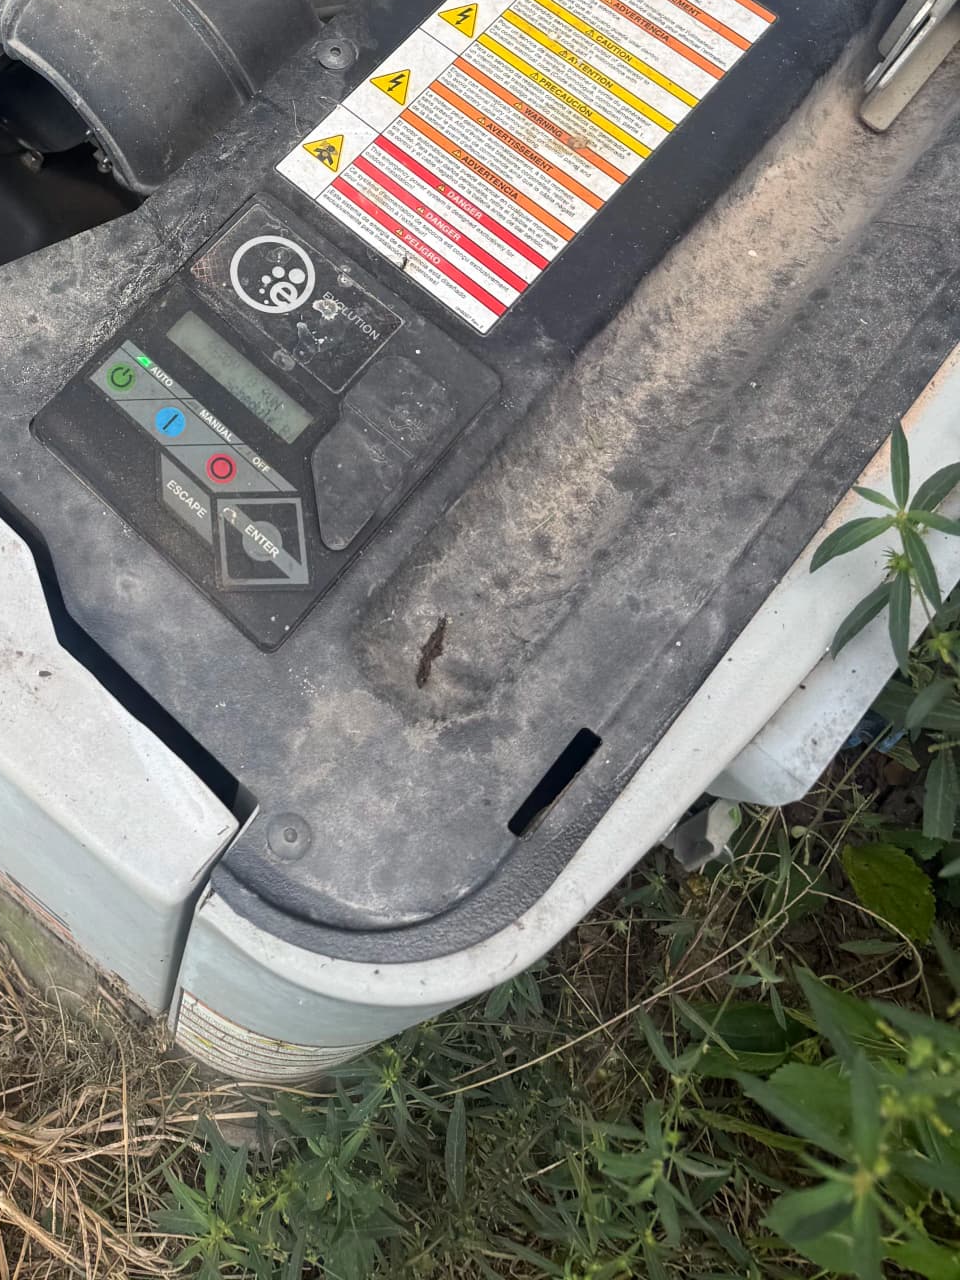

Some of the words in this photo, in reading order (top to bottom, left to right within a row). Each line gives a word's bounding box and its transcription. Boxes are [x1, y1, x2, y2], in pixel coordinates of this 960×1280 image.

[612, 1, 671, 42] ADVERTENCIA
[594, 34, 633, 62] CAUTION
[537, 76, 594, 117] PRECAUCIÓN
[522, 107, 564, 138] WARNING
[485, 121, 553, 173] AVERTISSEMENT
[460, 154, 520, 200] ADVERTENCIA
[446, 190, 483, 219] DANGER
[424, 211, 461, 241] DANGER
[402, 233, 441, 265] PELIGRO
[148, 364, 174, 388] AUTO
[196, 408, 236, 443] MANUAL
[250, 454, 272, 475] OFF
[164, 478, 208, 519] ESCAPE
[242, 523, 281, 559] ENTER
